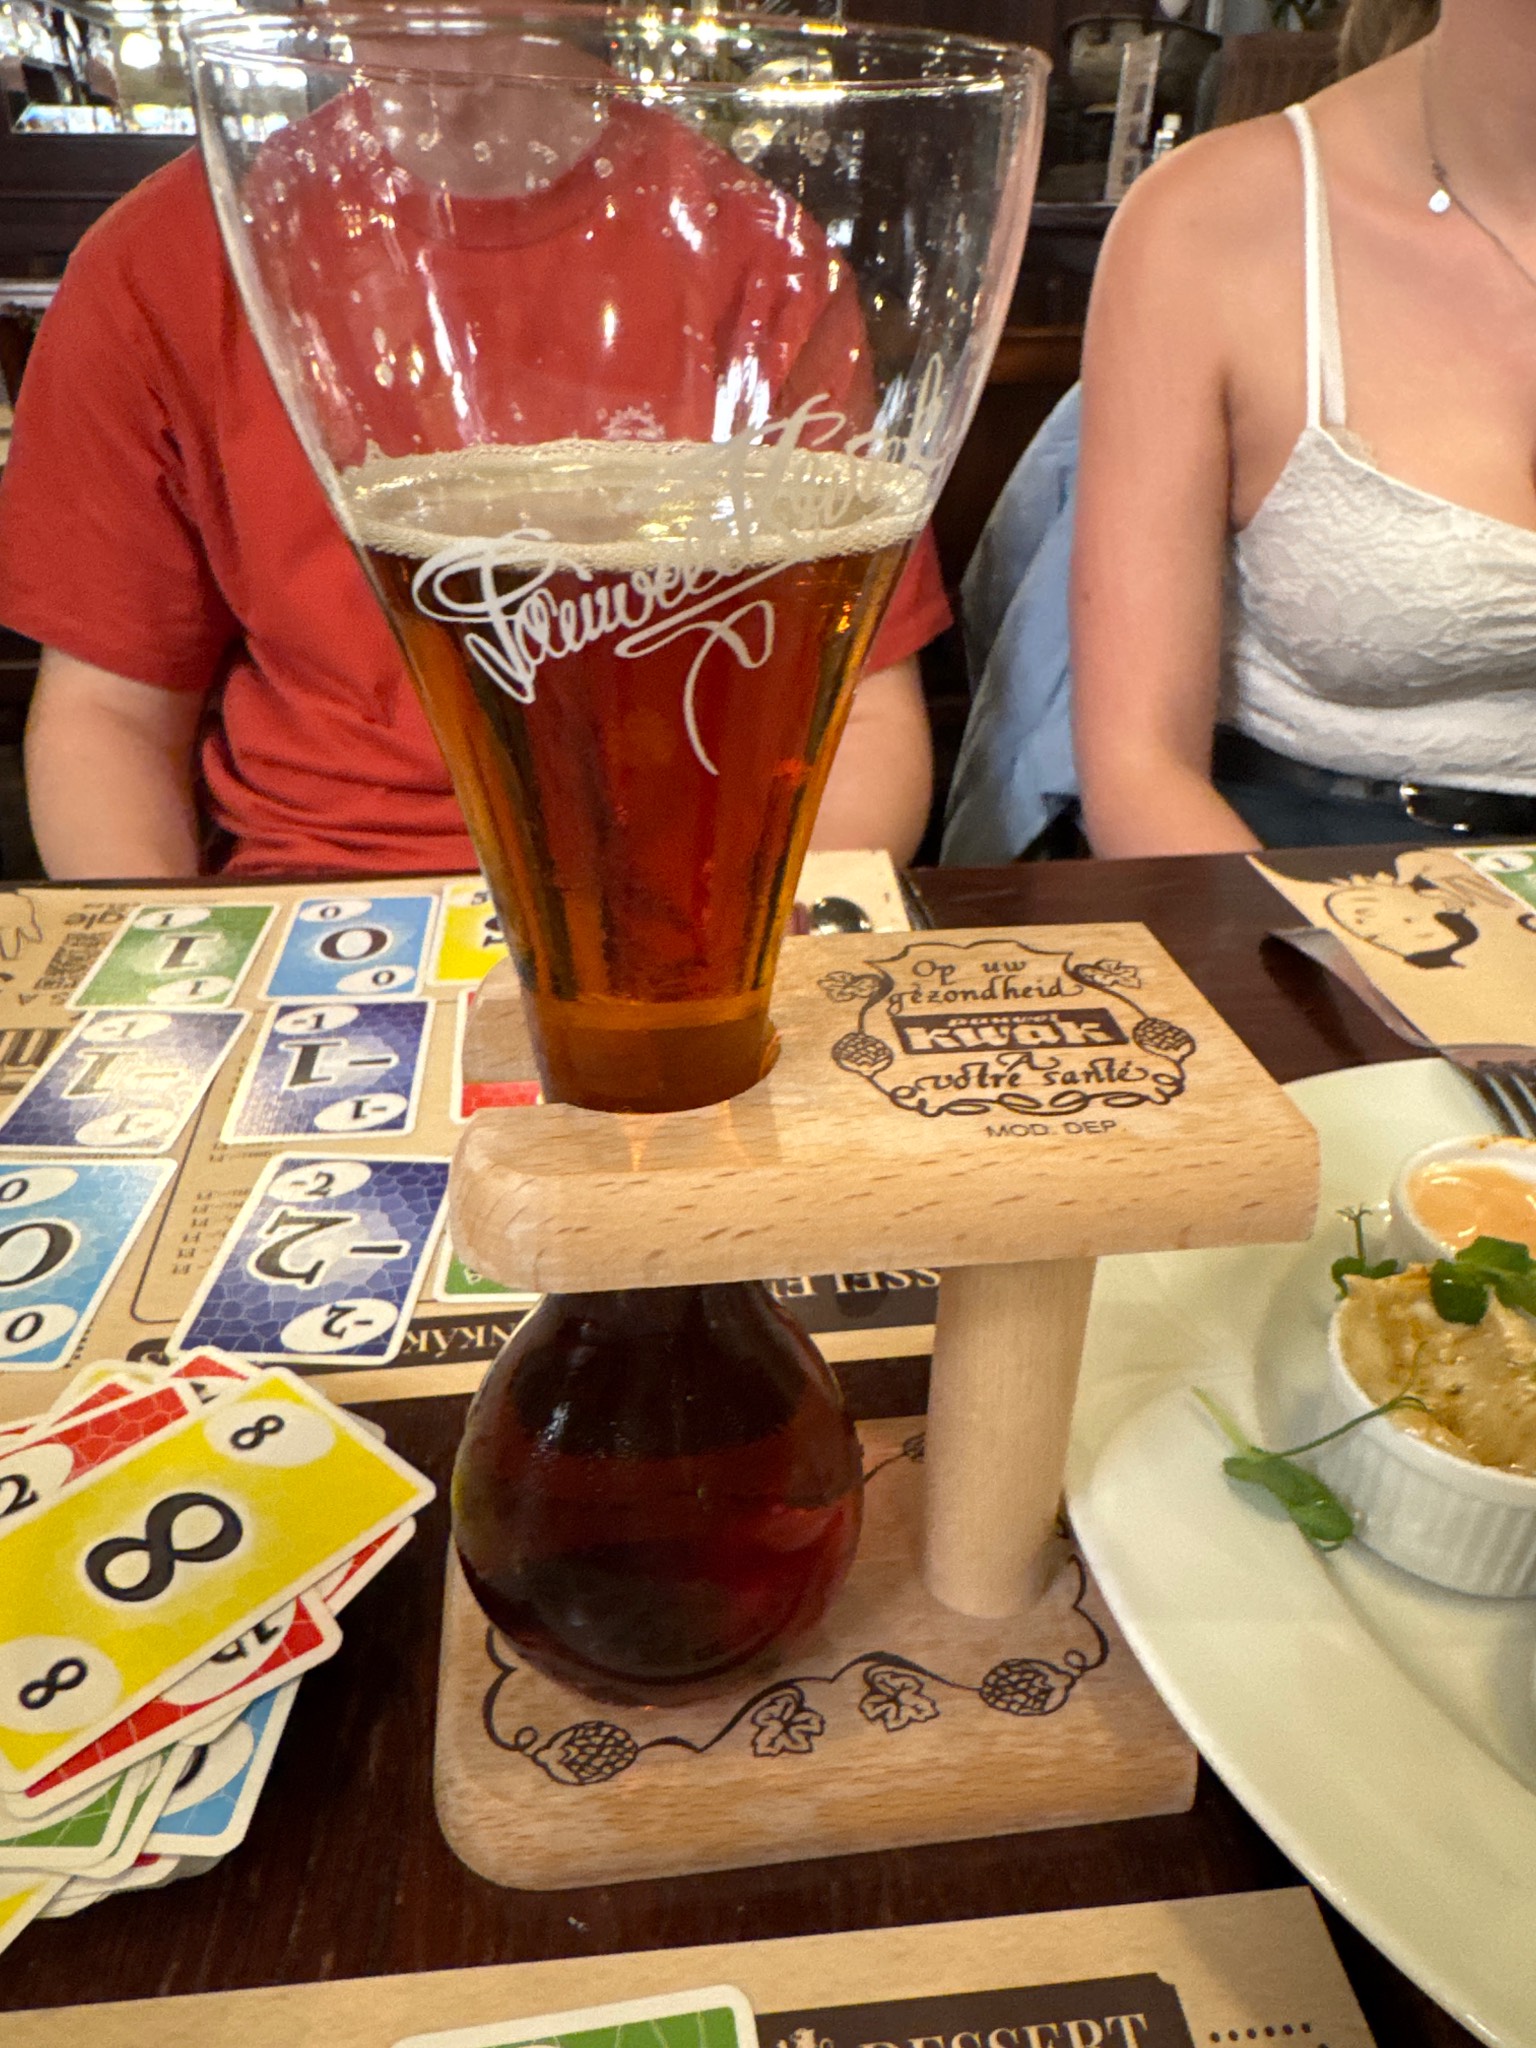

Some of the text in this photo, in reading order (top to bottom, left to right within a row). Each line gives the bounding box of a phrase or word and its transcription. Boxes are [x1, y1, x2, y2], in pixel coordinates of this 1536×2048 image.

[161, 913, 174, 927] 1
[319, 905, 341, 920] 0
[160, 934, 218, 969] 1
[320, 927, 388, 961] 0
[189, 980, 204, 996] 1
[371, 969, 396, 986] 0
[912, 959, 1027, 986] Op uw
[102, 1020, 138, 1038] -1
[292, 1013, 325, 1030] -1
[284, 1040, 393, 1087] -1
[352, 1098, 388, 1121] -1
[0, 1177, 29, 1202] 0
[291, 1171, 336, 1197] -2
[0, 1222, 73, 1288] 0
[254, 1209, 404, 1286] -2
[5, 1311, 44, 1344] 0
[321, 1304, 374, 1339] -2
[230, 1414, 285, 1451] 8
[84, 1491, 244, 1603] 8
[18, 1656, 89, 1710] 8
[858, 2013, 1150, 2048] SERT
